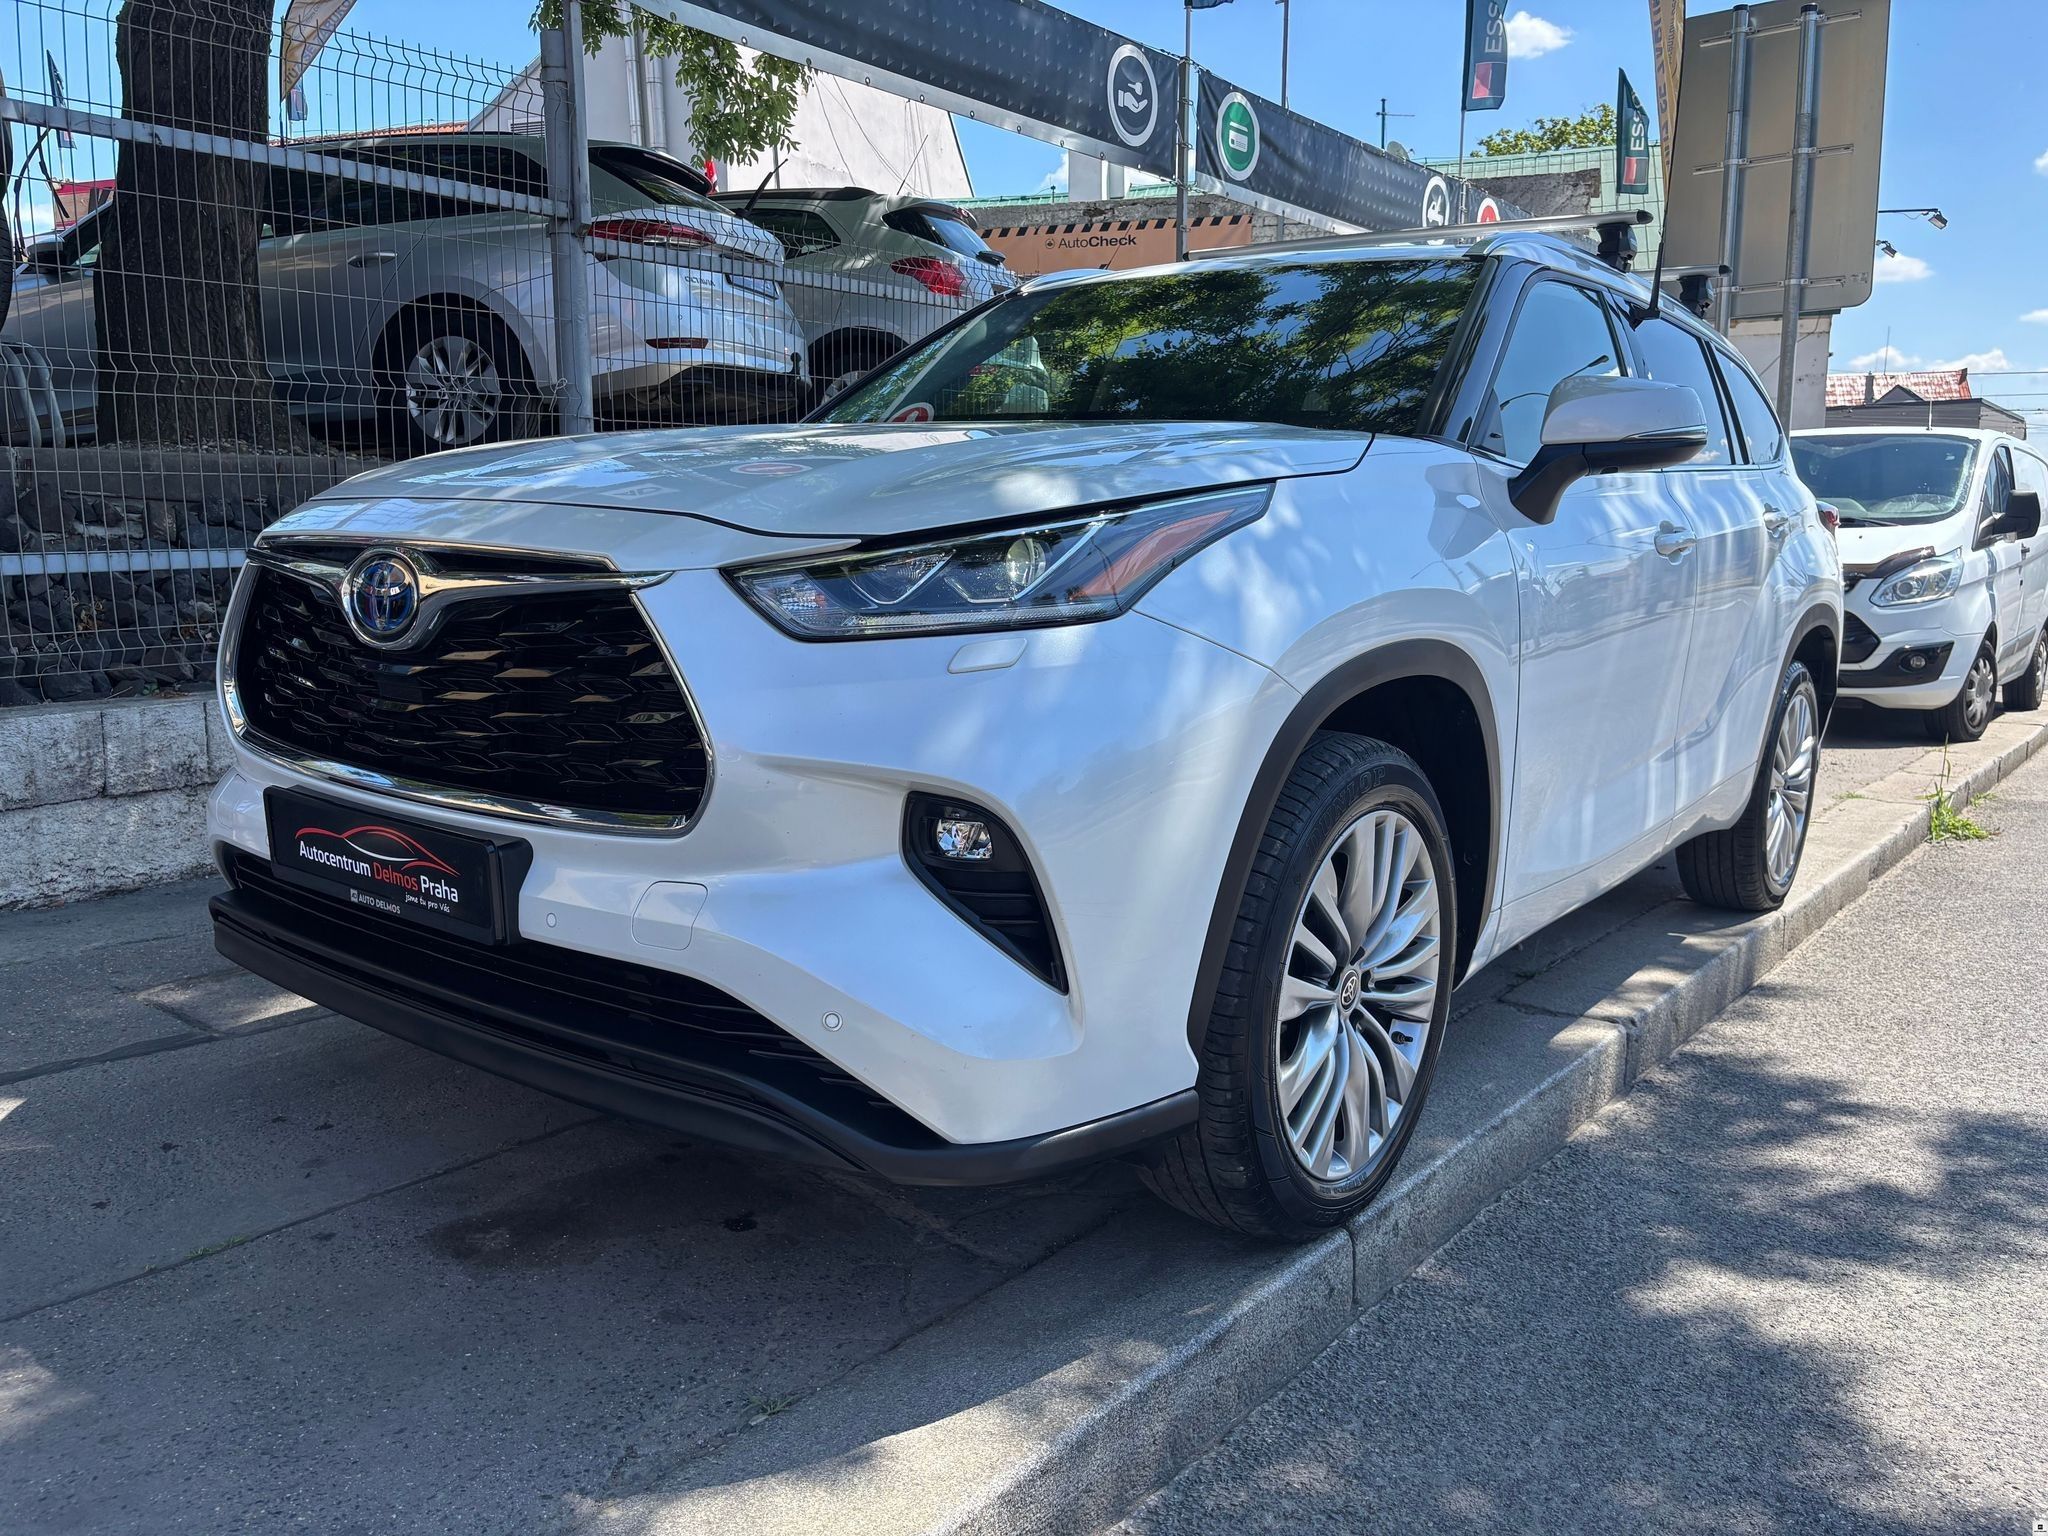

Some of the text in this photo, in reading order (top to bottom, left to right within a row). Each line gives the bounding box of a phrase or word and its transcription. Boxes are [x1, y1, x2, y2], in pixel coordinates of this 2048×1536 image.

[1058, 234, 1137, 249] AutoCheck
[300, 840, 459, 903] Autocentrum Delmos Praha
[358, 893, 375, 906] AUTO
[375, 899, 401, 914] DELMOS
